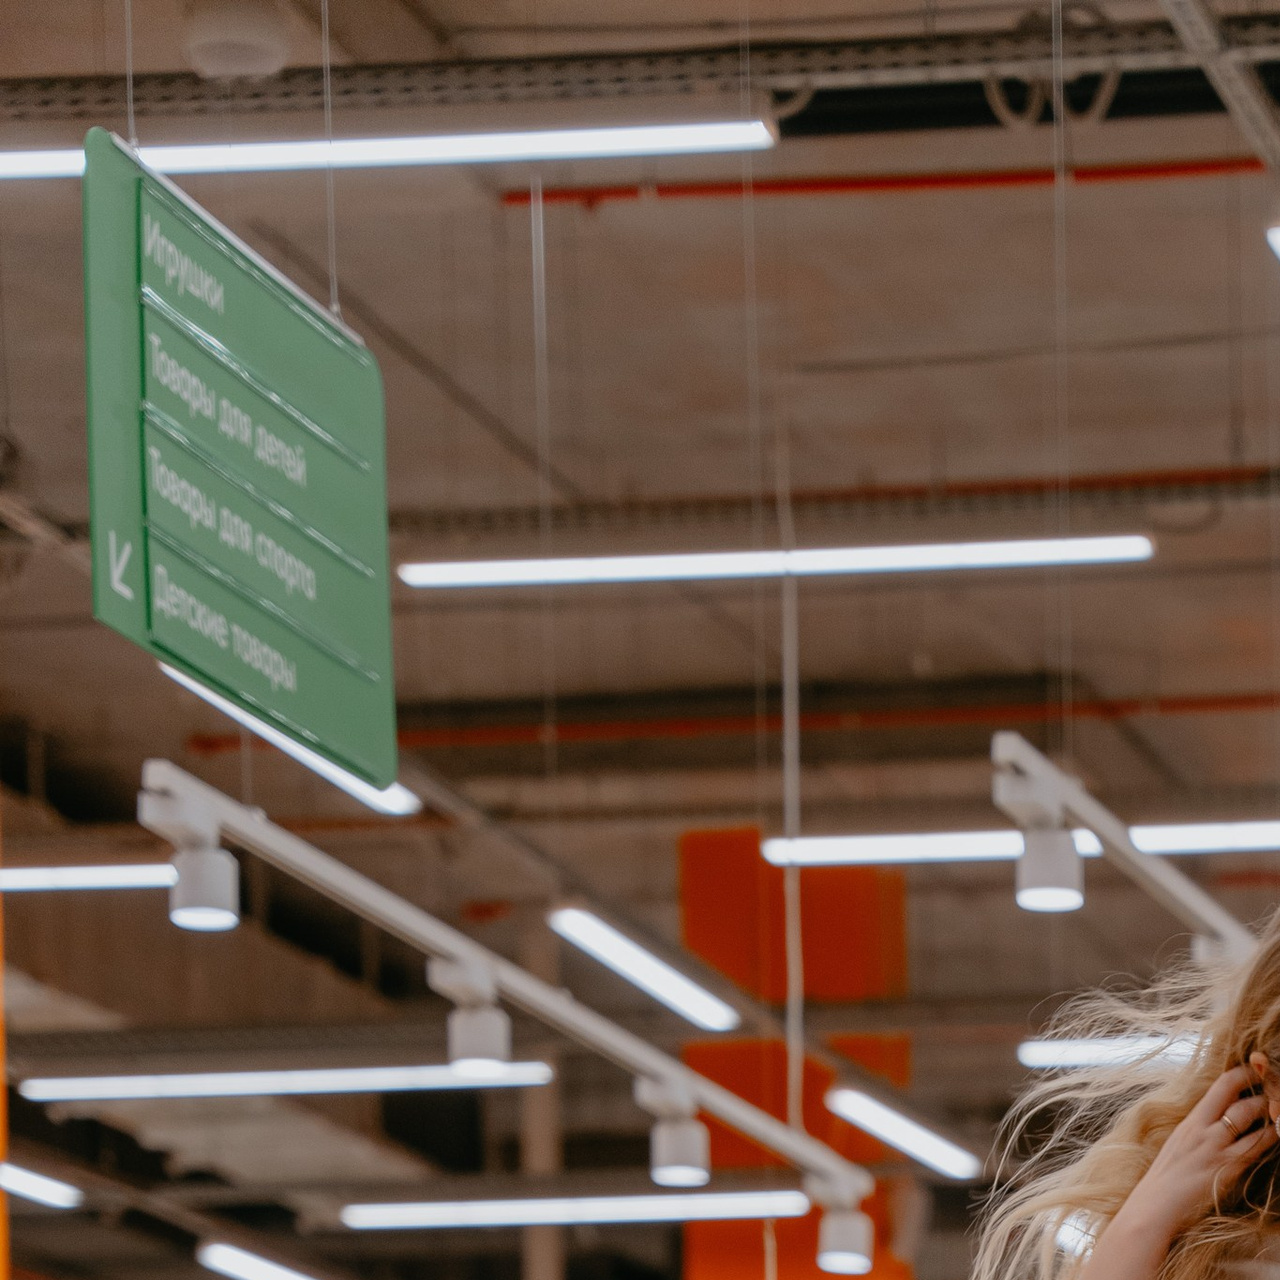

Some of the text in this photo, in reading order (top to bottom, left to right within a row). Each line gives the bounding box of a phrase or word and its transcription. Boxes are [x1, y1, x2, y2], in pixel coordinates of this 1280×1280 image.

[143, 213, 224, 314] Игрушки
[149, 333, 307, 487] Товары для детей
[149, 446, 317, 600] Товары для спорта
[154, 564, 296, 692] Детские товары
